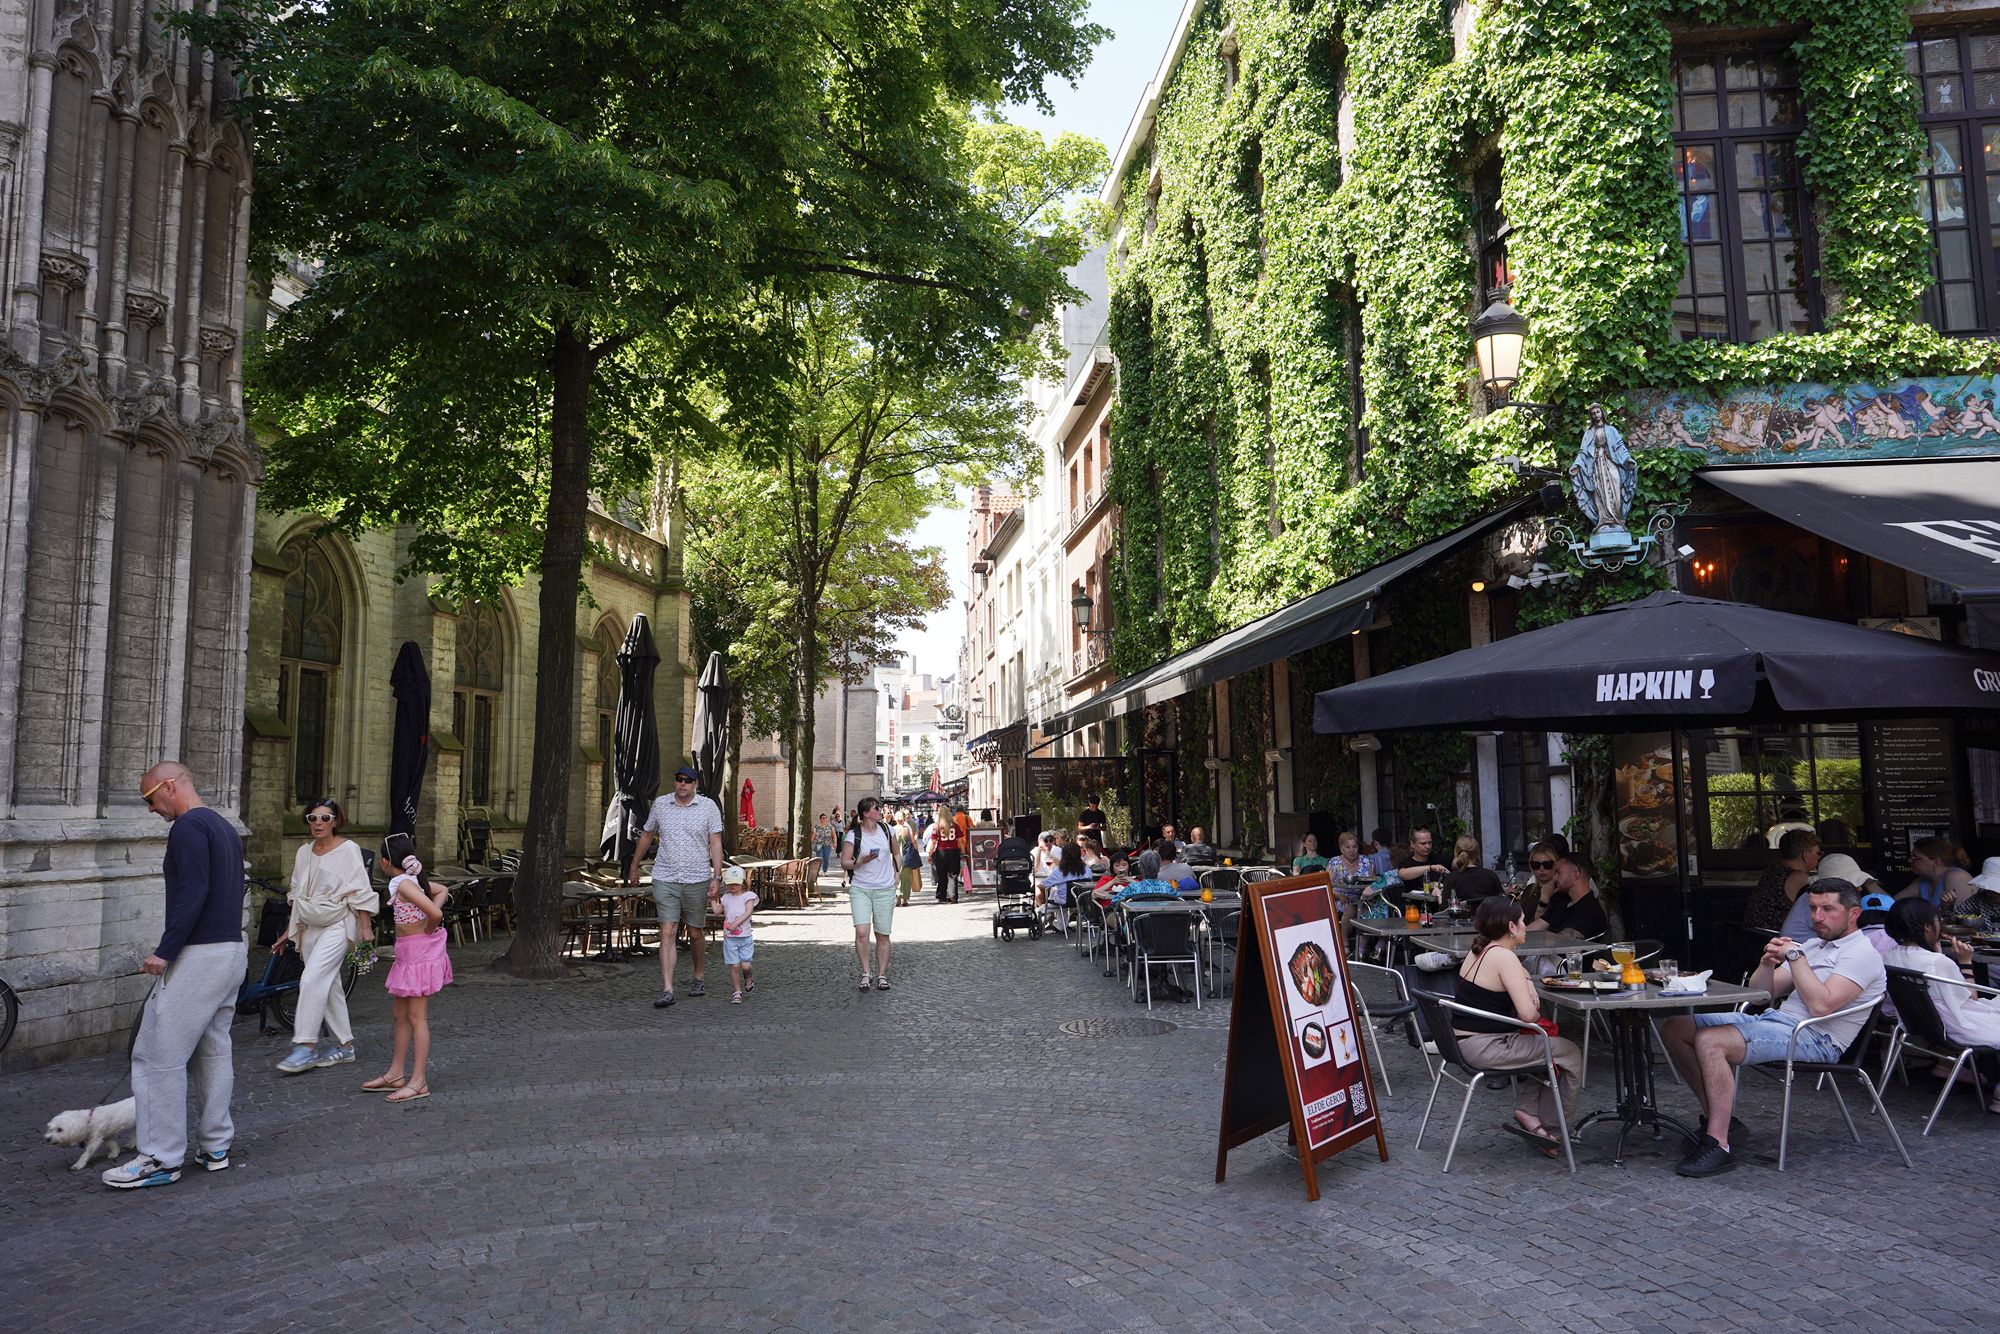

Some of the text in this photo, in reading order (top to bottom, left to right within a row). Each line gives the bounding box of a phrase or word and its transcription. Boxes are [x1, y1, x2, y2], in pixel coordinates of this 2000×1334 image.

[1596, 669, 1693, 702] HAPKIN
[1307, 1091, 1345, 1116] ELFDE GEBOD
